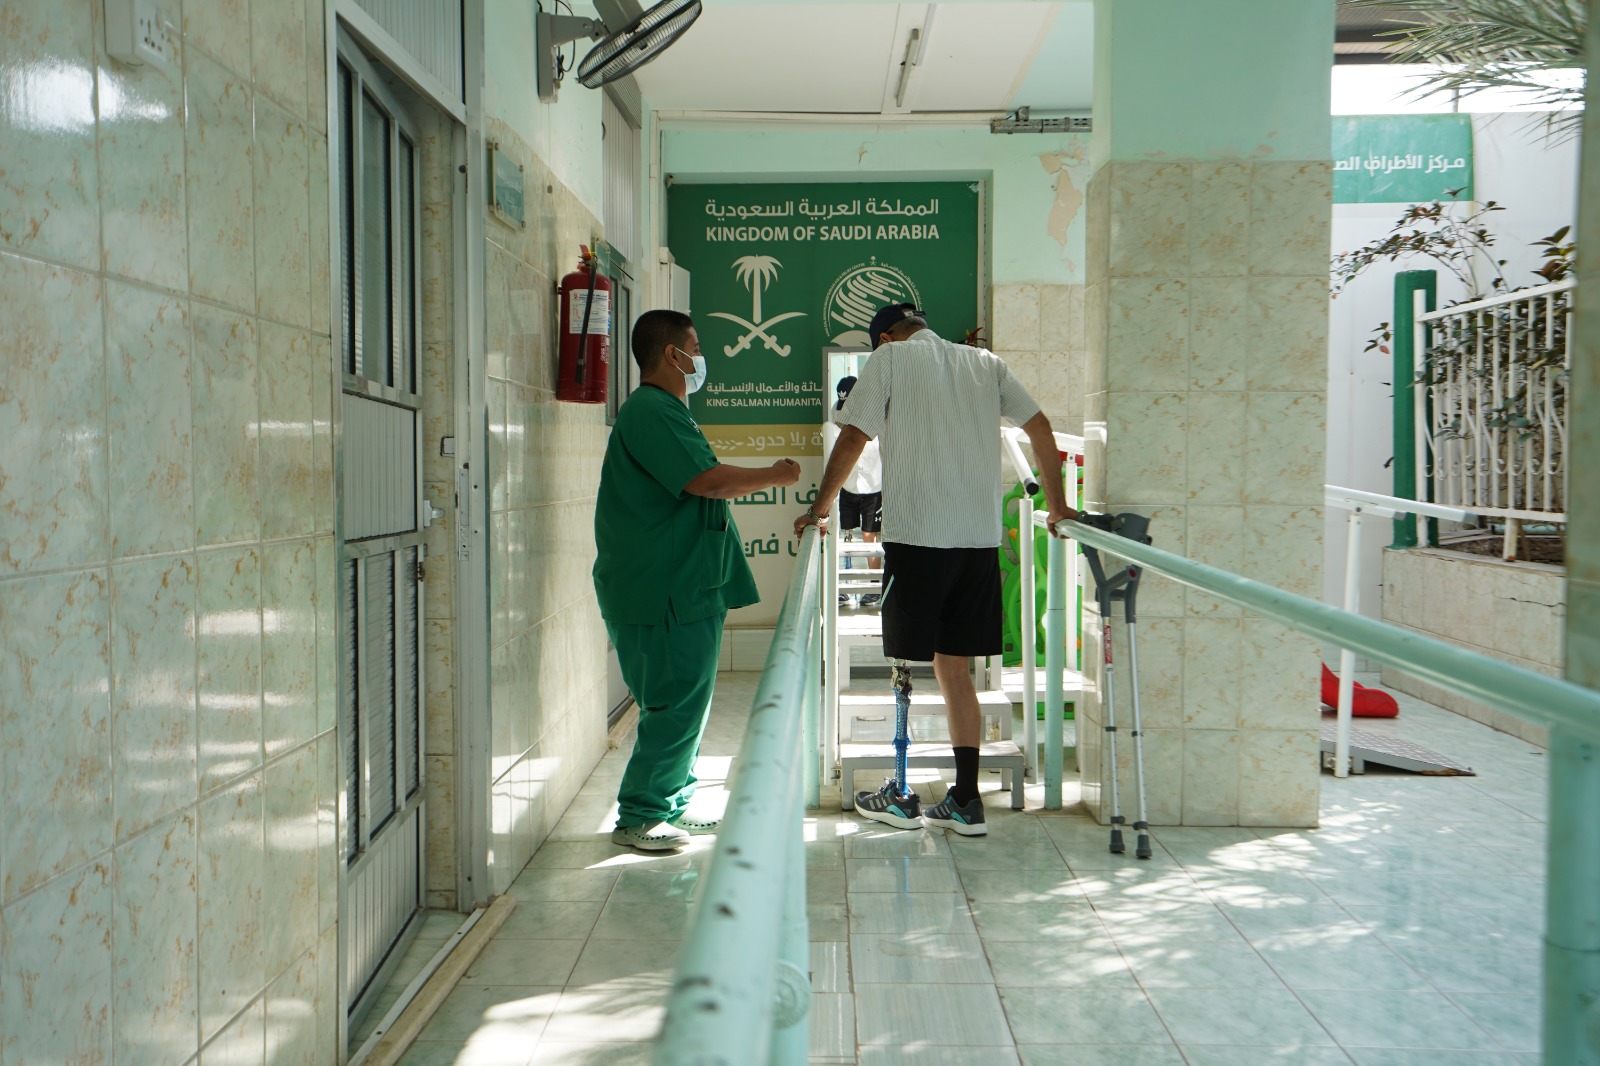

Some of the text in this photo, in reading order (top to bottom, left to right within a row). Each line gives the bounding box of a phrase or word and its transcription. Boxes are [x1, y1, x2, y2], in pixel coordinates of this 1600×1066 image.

[1332, 156, 1361, 171] الص
[1424, 154, 1465, 174] مركز
[705, 197, 939, 221] المملكة العربية السعودية
[705, 224, 940, 242] KINGDOM OF SAUDI ARABIA
[706, 382, 754, 395] الإنسانية
[706, 397, 823, 408] KING SALMAN HUMANITA
[747, 434, 785, 451] حدود
